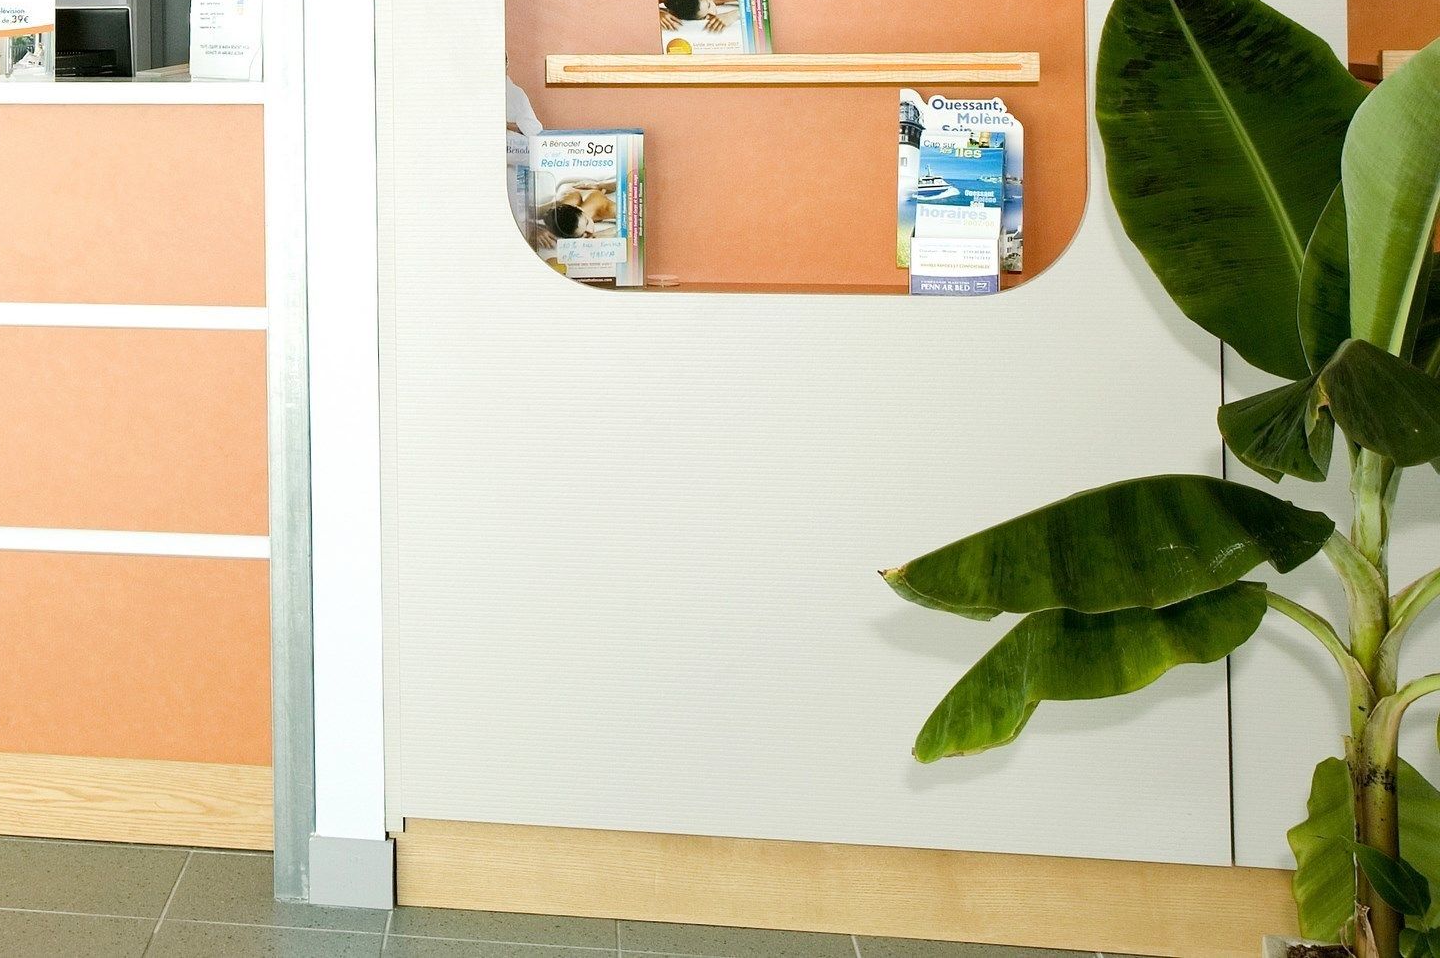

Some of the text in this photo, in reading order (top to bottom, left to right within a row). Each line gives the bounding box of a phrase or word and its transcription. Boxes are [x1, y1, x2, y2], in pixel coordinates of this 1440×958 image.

[2, 16, 9, 24] de
[11, 14, 29, 24] 39€
[931, 98, 1003, 113] Ouessant,
[957, 112, 1014, 127] Molène,
[567, 147, 585, 155] mon
[586, 141, 614, 157] Spa
[923, 139, 956, 150] Cap sur
[541, 158, 614, 168] Relais Thalasso
[919, 206, 988, 220] horaires
[920, 283, 971, 292] PENN AR BED
